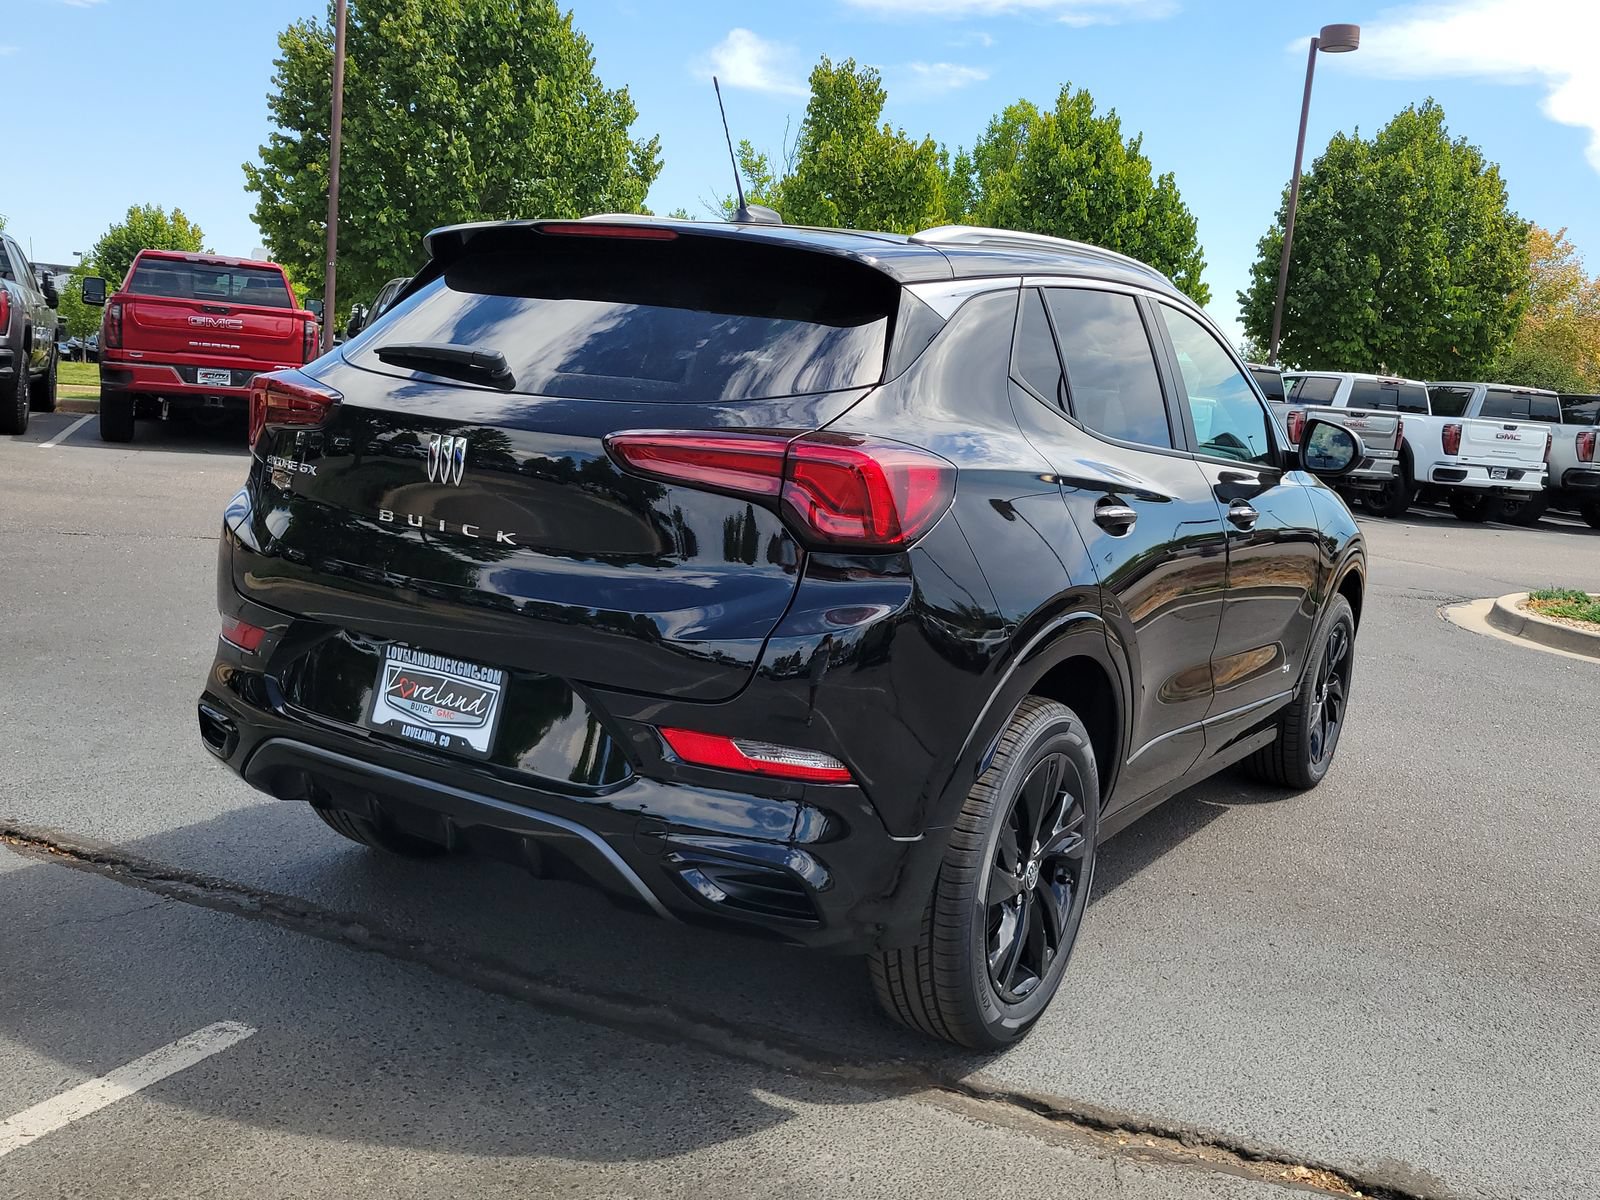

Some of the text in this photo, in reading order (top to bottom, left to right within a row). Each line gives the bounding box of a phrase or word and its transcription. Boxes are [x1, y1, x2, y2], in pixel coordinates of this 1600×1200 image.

[188, 316, 243, 329] GMC
[1495, 432, 1522, 441] GMC
[299, 462, 318, 477] GX
[378, 508, 517, 546] BUICK
[386, 645, 502, 684] LOVELANDBUICKGMC.COM
[410, 702, 456, 720] BUICK GMC
[402, 725, 451, 747] LOVELAND, CO
